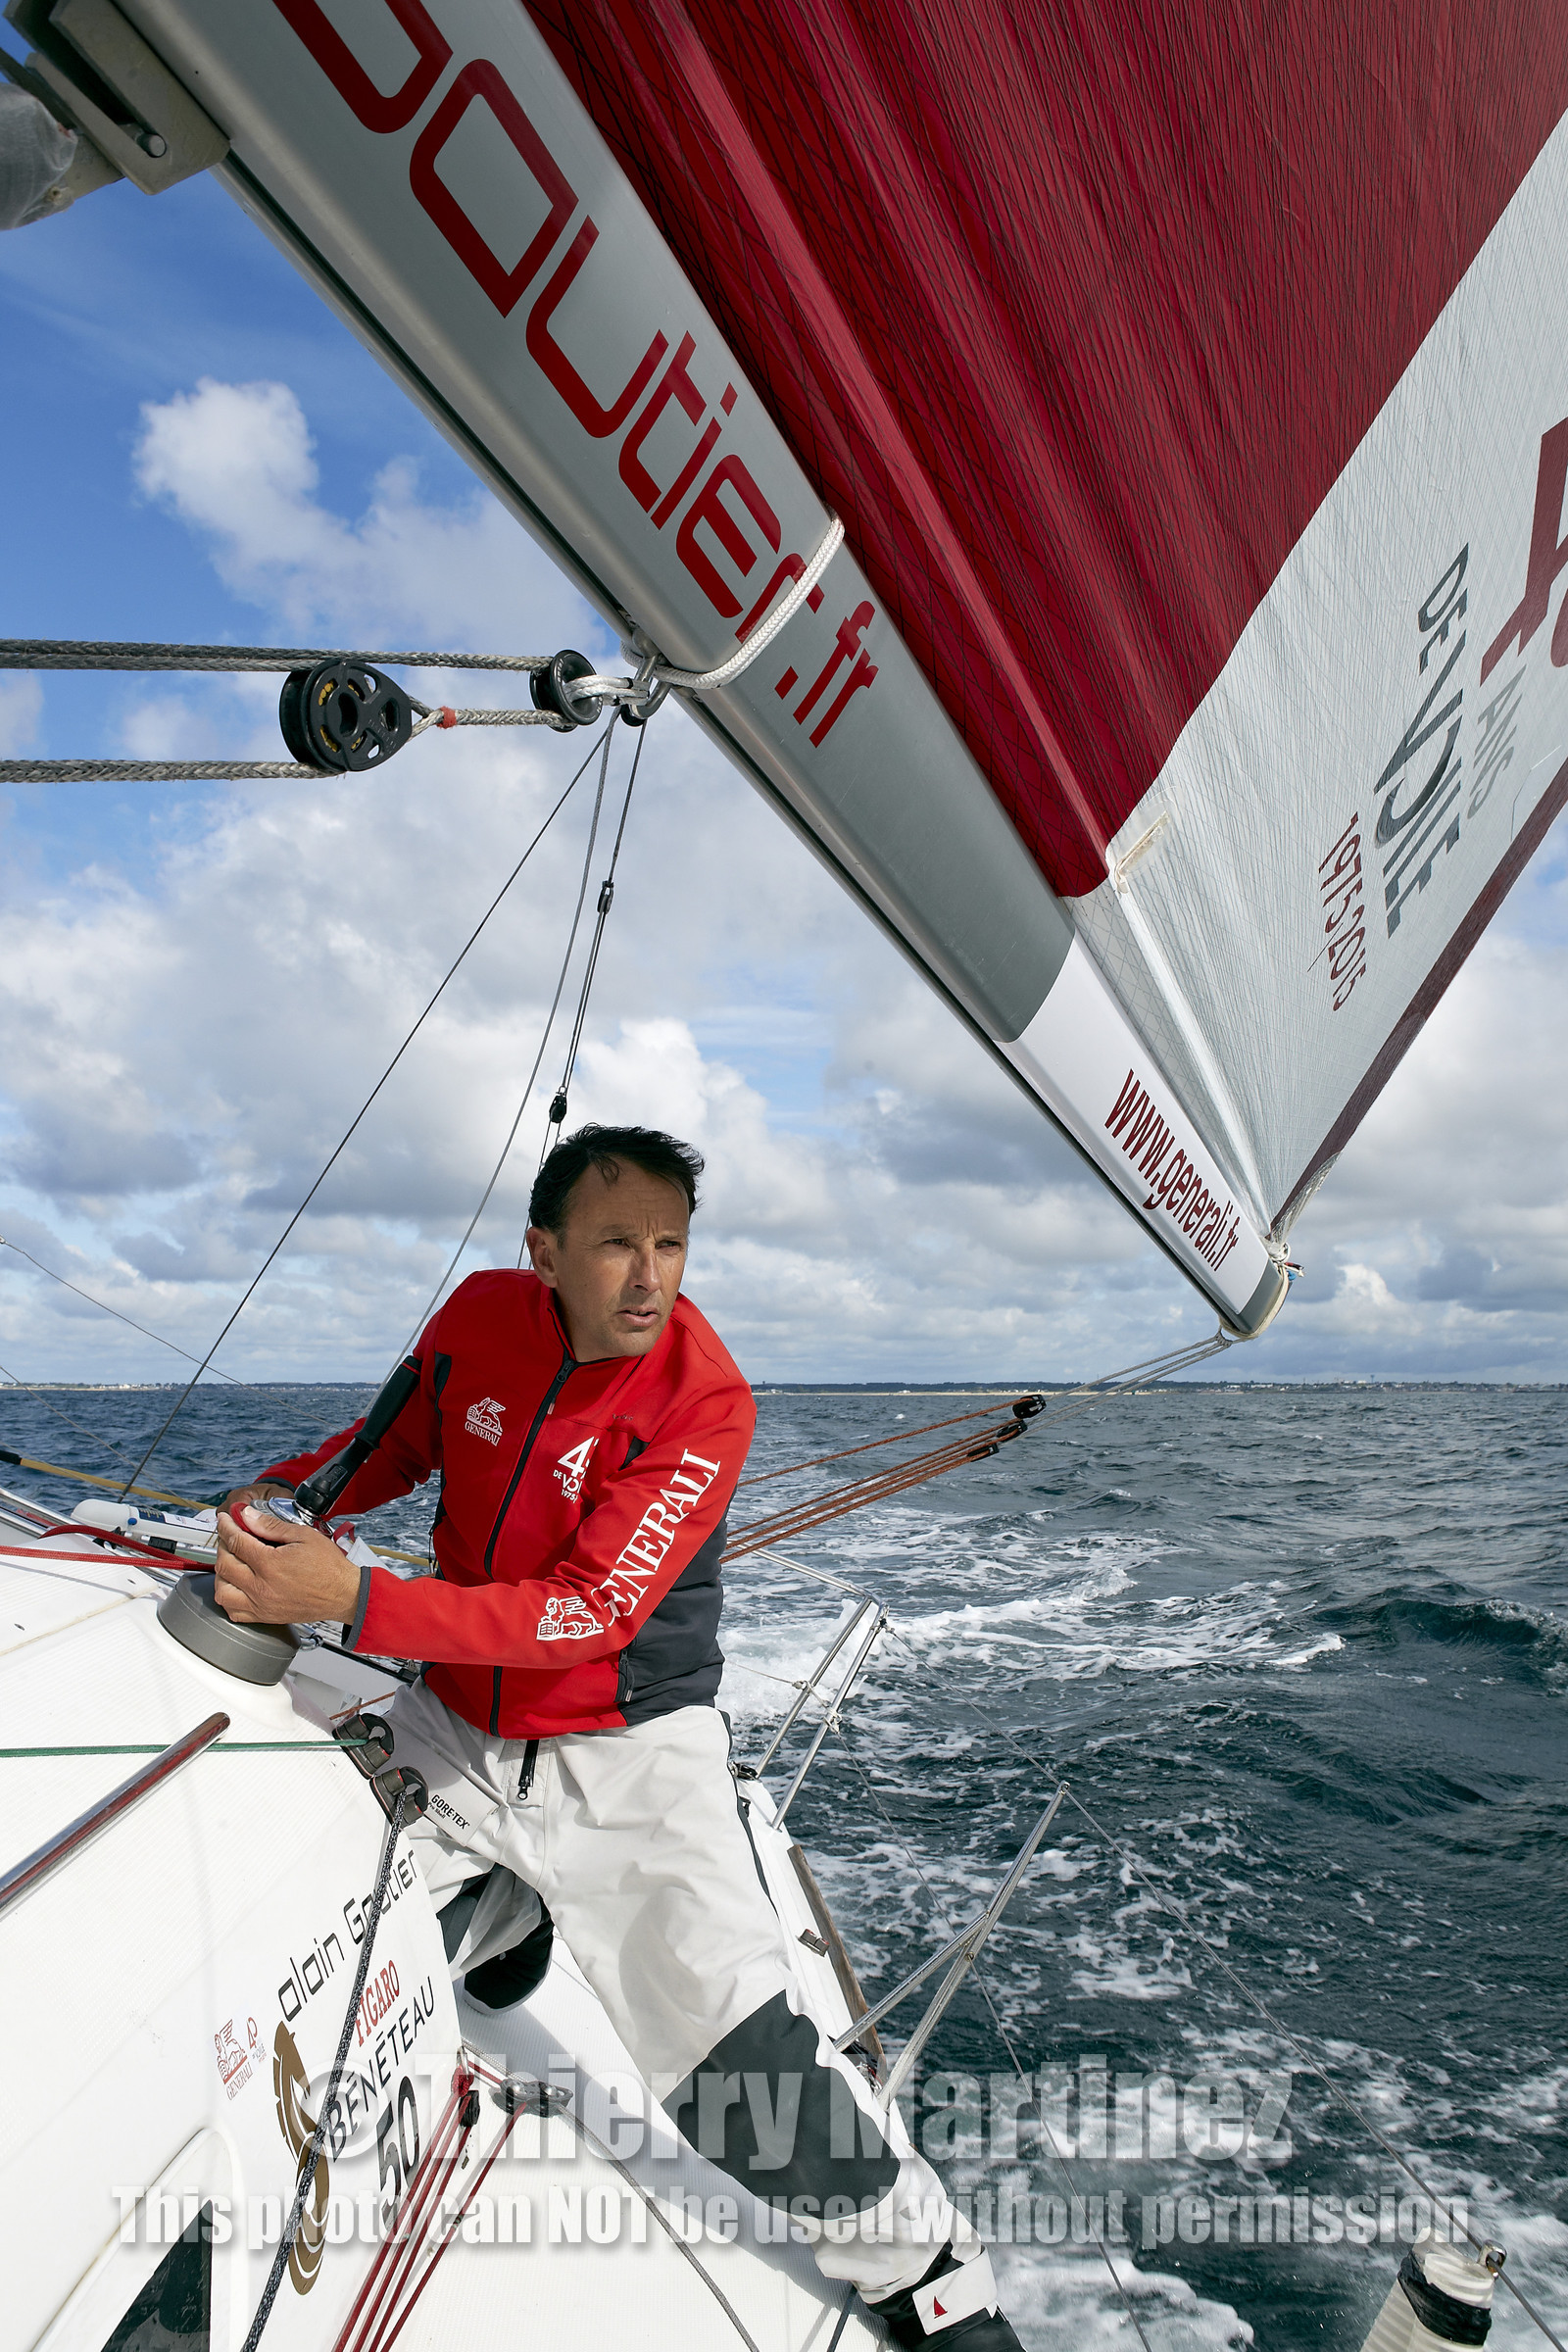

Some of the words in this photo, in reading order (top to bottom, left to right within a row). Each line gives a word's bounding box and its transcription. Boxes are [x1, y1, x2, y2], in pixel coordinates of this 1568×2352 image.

[1417, 541, 1469, 676] DE
[1467, 663, 1528, 820] ANS
[1103, 1068, 1241, 1273] www.generali.fr
[465, 1420, 501, 1447] GENERALI
[553, 1469, 564, 1481] DE
[355, 1959, 400, 2047] FIGARO
[226, 2062, 253, 2100] GENERALI
[376, 2076, 420, 2232] 50
